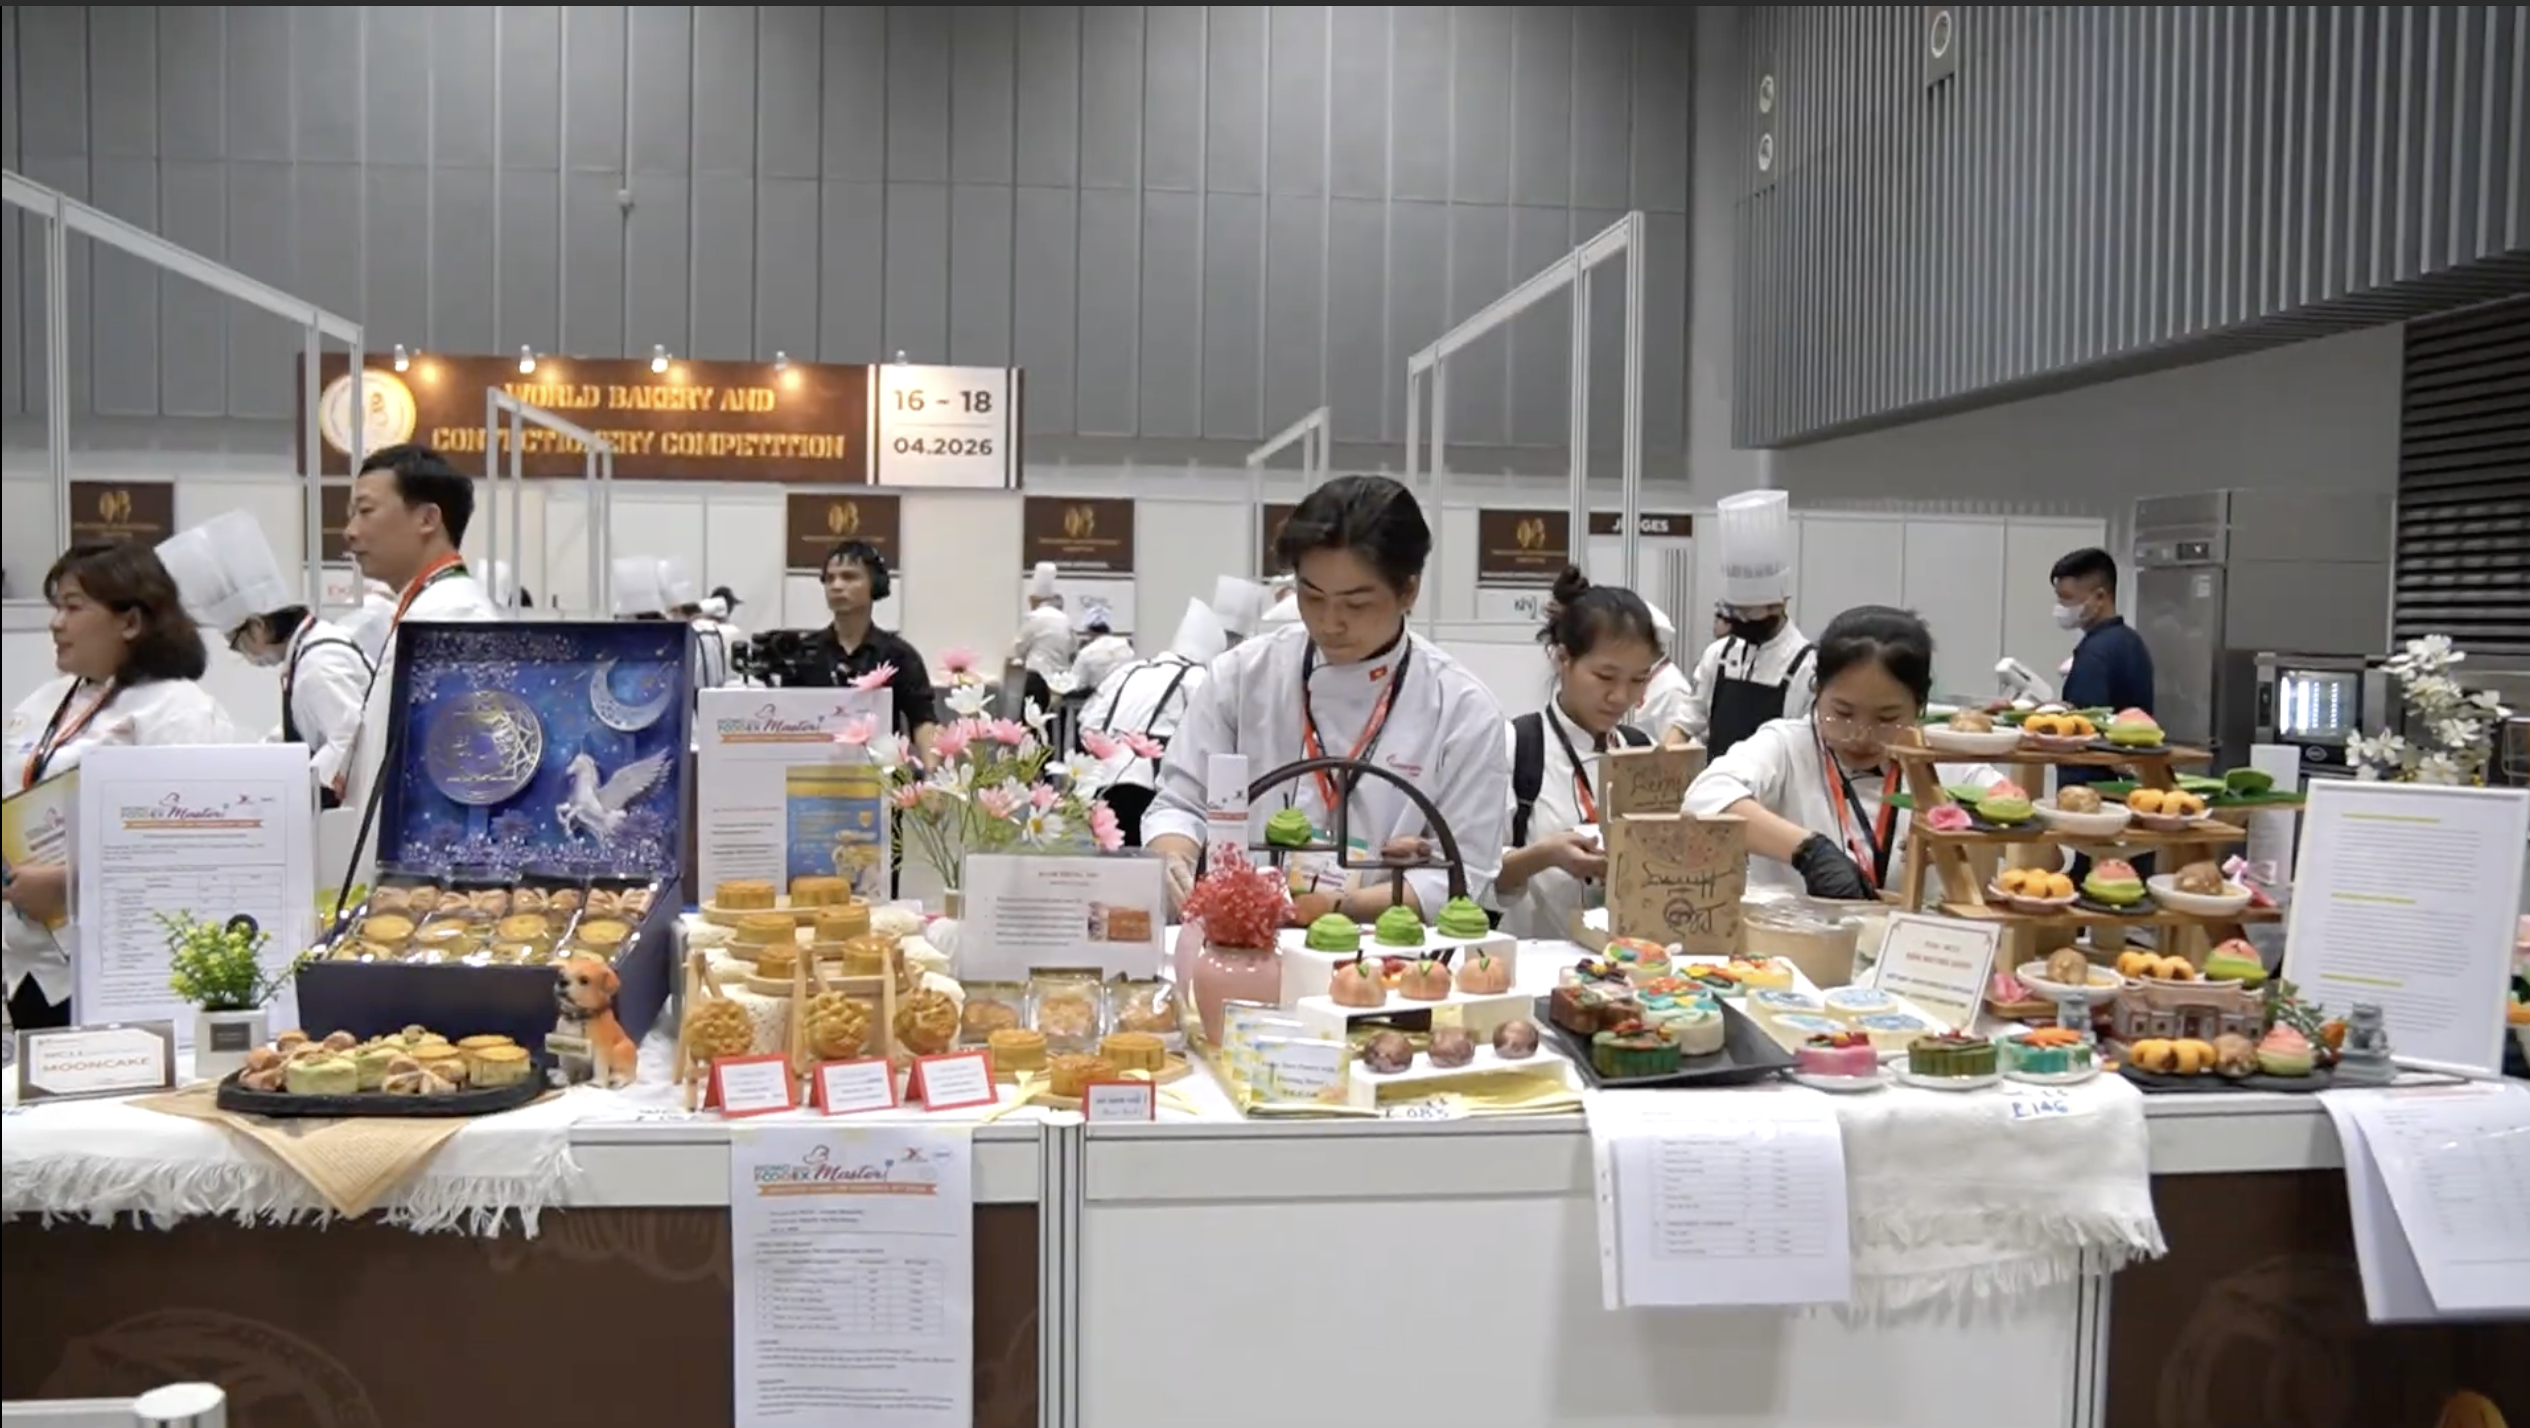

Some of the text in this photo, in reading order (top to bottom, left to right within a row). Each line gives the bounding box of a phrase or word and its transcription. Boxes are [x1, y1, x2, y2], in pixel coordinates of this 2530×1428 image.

[504, 383, 776, 412] WORLD BAKERY AND
[894, 389, 925, 412] 16
[960, 390, 993, 414] 18
[661, 431, 846, 459] COMPETITION
[893, 437, 993, 456] 04.2026
[1611, 518, 1669, 533] JGES
